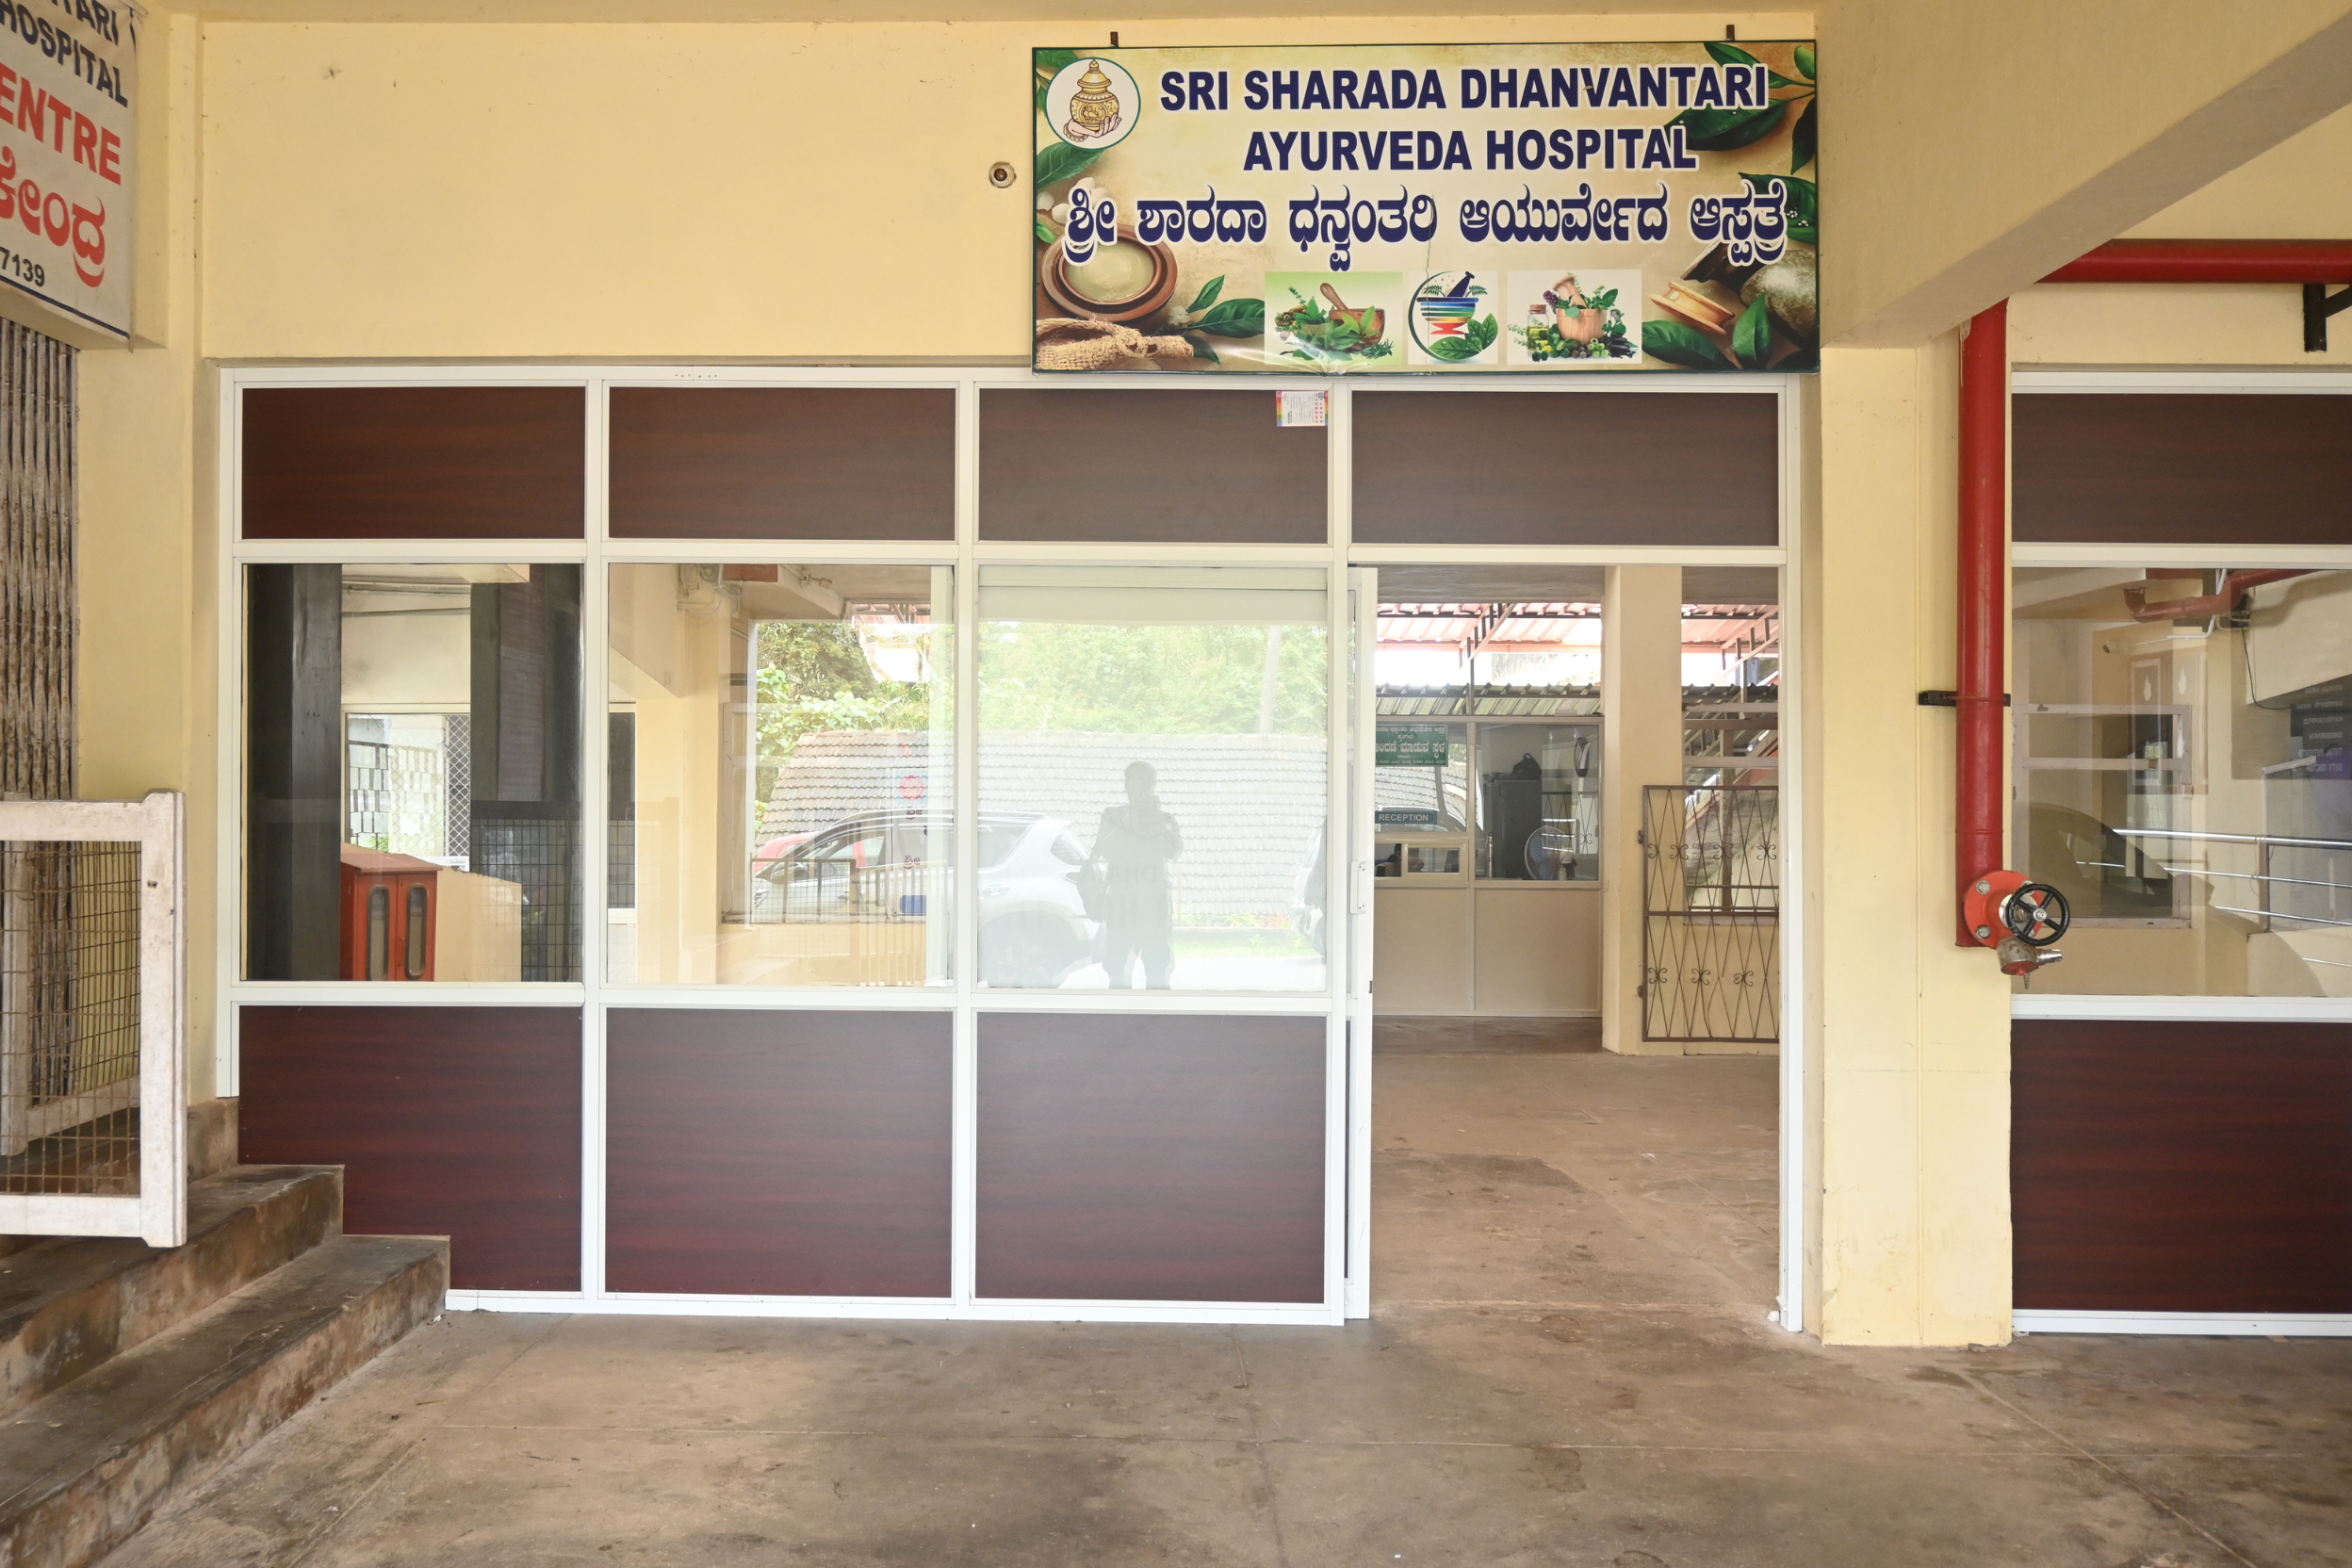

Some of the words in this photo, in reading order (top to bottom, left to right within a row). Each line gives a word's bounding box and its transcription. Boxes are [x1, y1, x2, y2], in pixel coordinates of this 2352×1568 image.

[1160, 71, 1229, 111] SRI
[1244, 69, 1447, 110] SHARADA
[1461, 67, 1766, 108] DHANVANTARI
[1243, 130, 1473, 172] AYURVEDA
[1487, 128, 1697, 171] HOSPITAL
[1065, 188, 1116, 263] ಶ್ರೀ
[1136, 185, 1267, 243] ಶಾರದಾ
[1288, 185, 1439, 271] ಧನ್ವಂತರಿ
[1460, 183, 1668, 243] ಆಯುರ್ವೇದ
[1690, 182, 1787, 264] ಆಸ್ಪತ್ರೆ
[1379, 813, 1429, 822] RECEPTION
